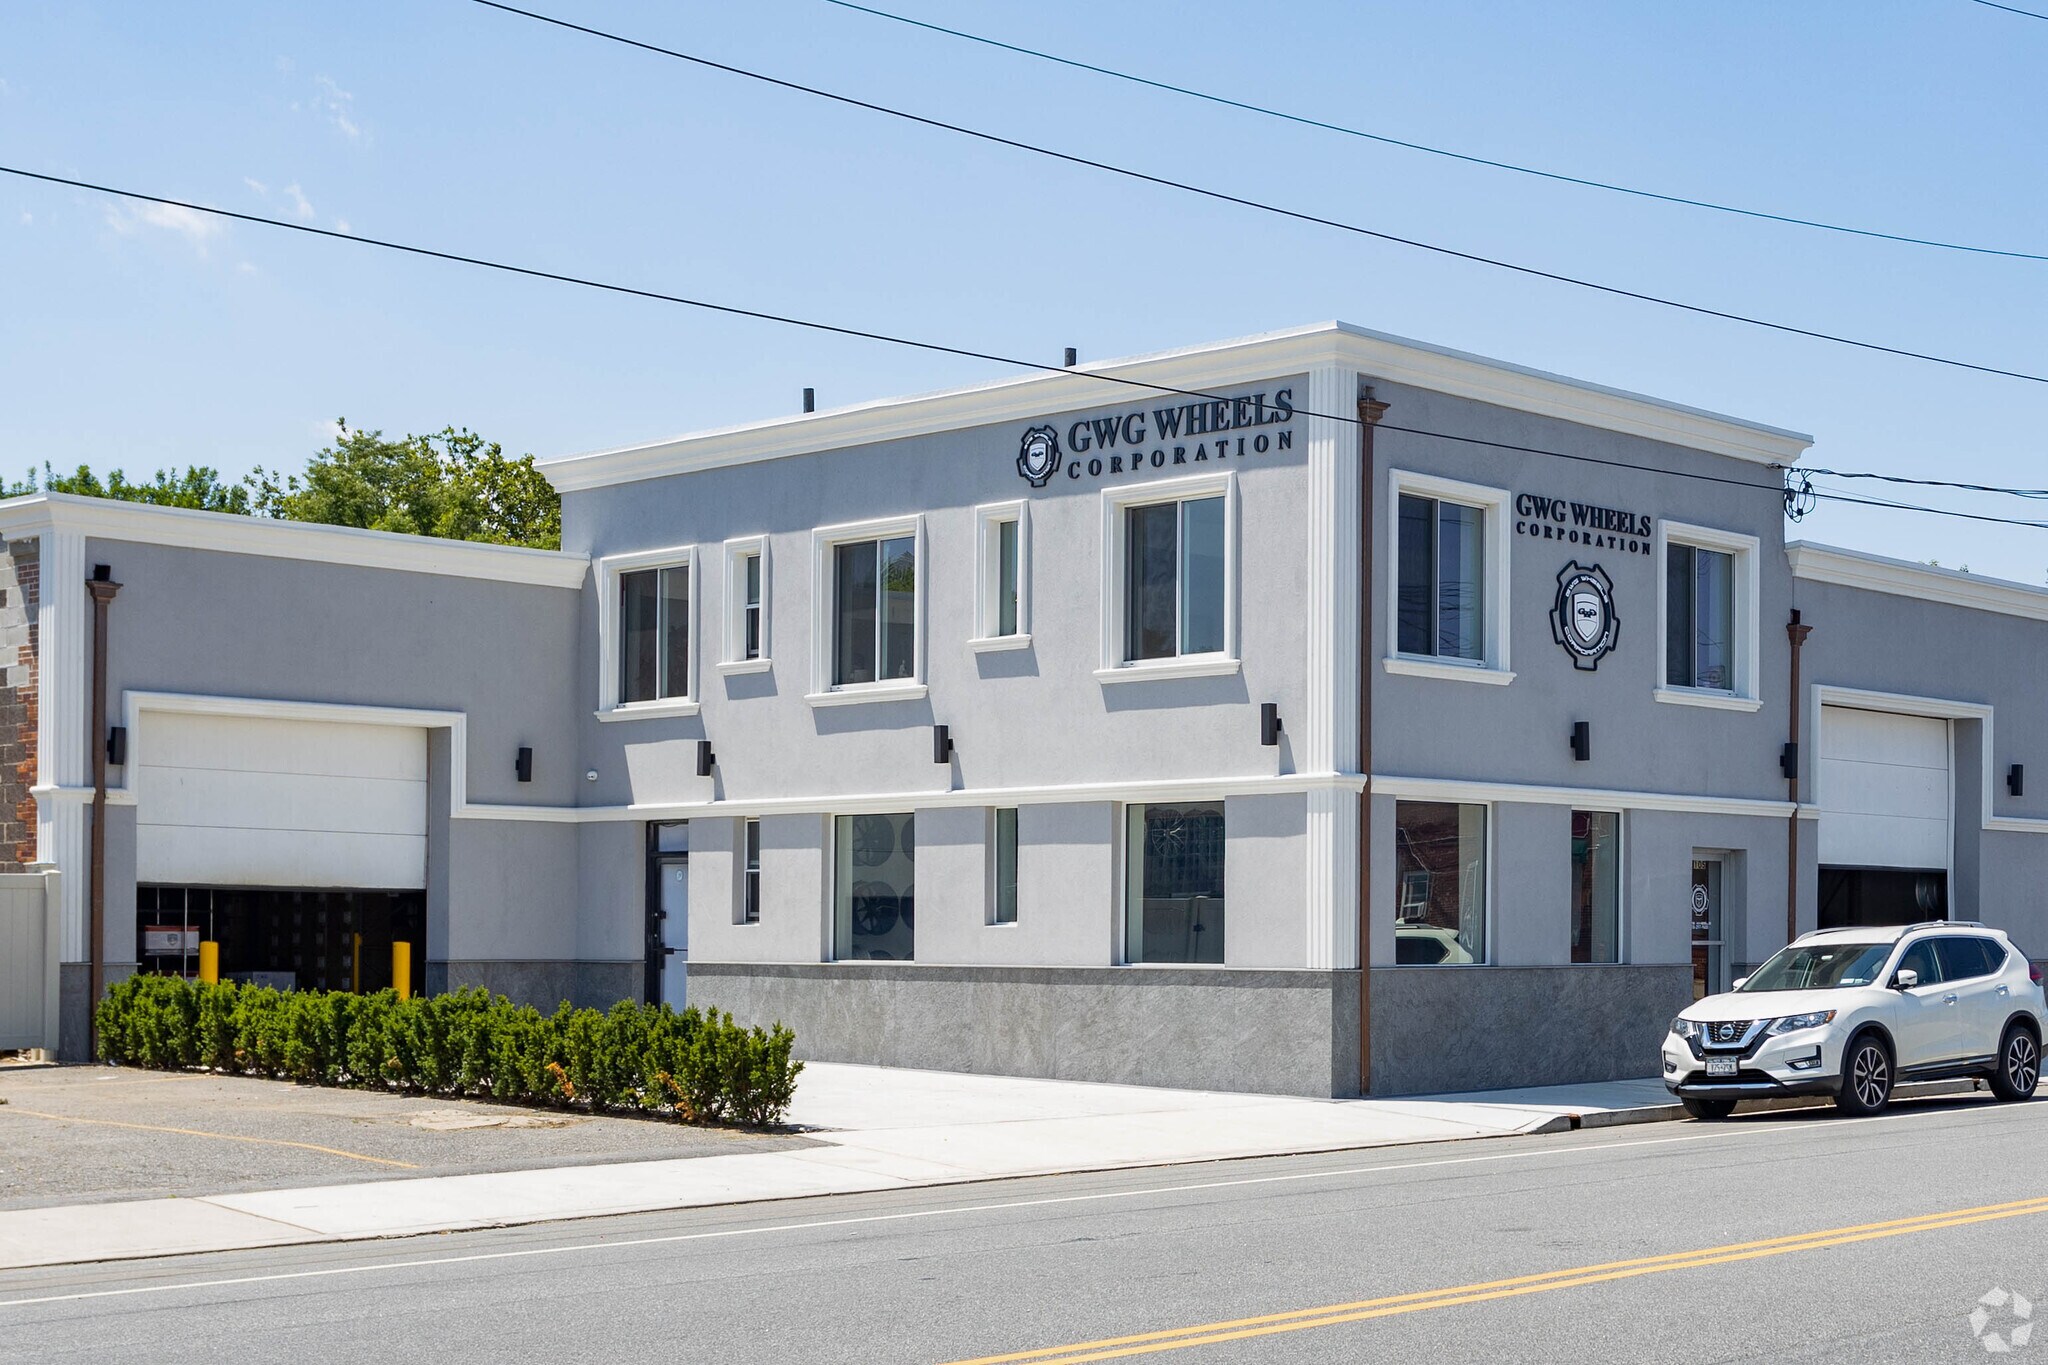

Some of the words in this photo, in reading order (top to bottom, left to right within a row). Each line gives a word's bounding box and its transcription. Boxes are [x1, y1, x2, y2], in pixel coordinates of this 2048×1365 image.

[1067, 412, 1146, 452] GWG
[1152, 389, 1293, 440] WHEELS
[1067, 430, 1293, 479] CORPORATION
[1516, 493, 1566, 522] GWG
[1569, 502, 1652, 537] WHEELS
[1516, 521, 1651, 555] CORPORATION
